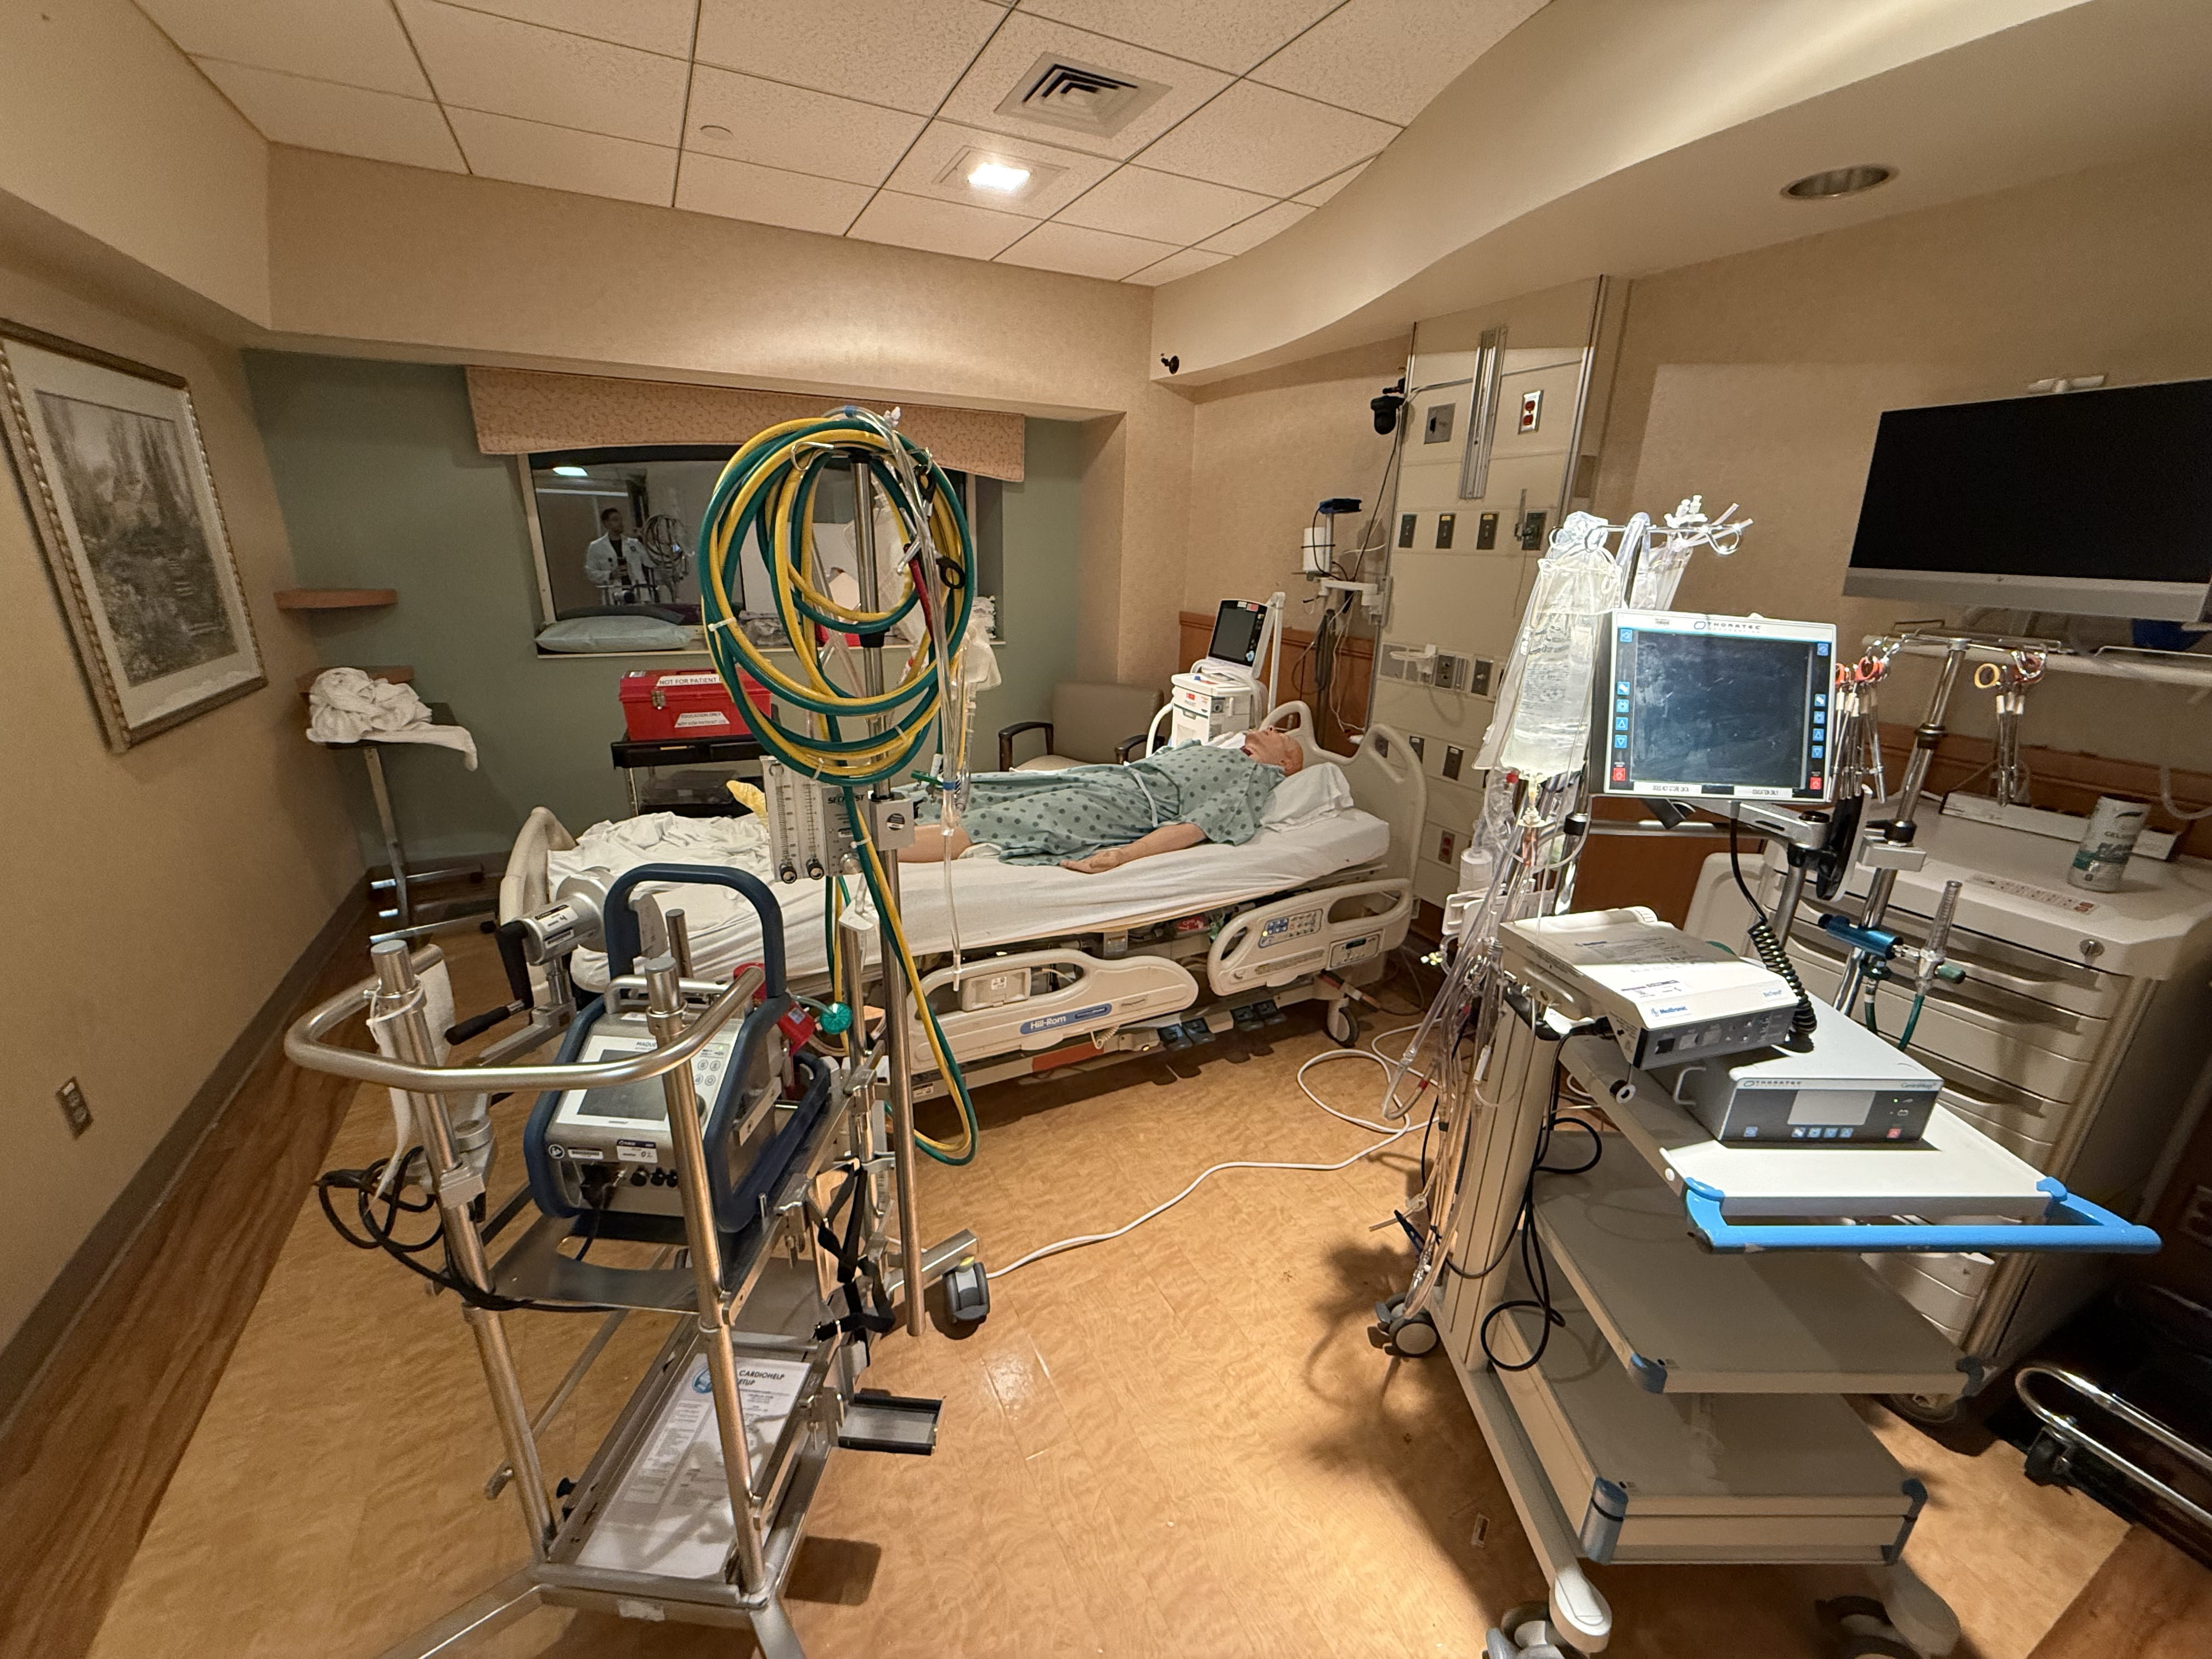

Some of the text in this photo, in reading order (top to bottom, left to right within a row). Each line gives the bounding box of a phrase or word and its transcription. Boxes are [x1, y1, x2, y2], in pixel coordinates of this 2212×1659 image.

[1707, 622, 1760, 630] THORATEC
[828, 794, 865, 804] SECST
[1030, 1016, 1066, 1029] Hill-Rom
[739, 1370, 785, 1380] CARDIOHELP
